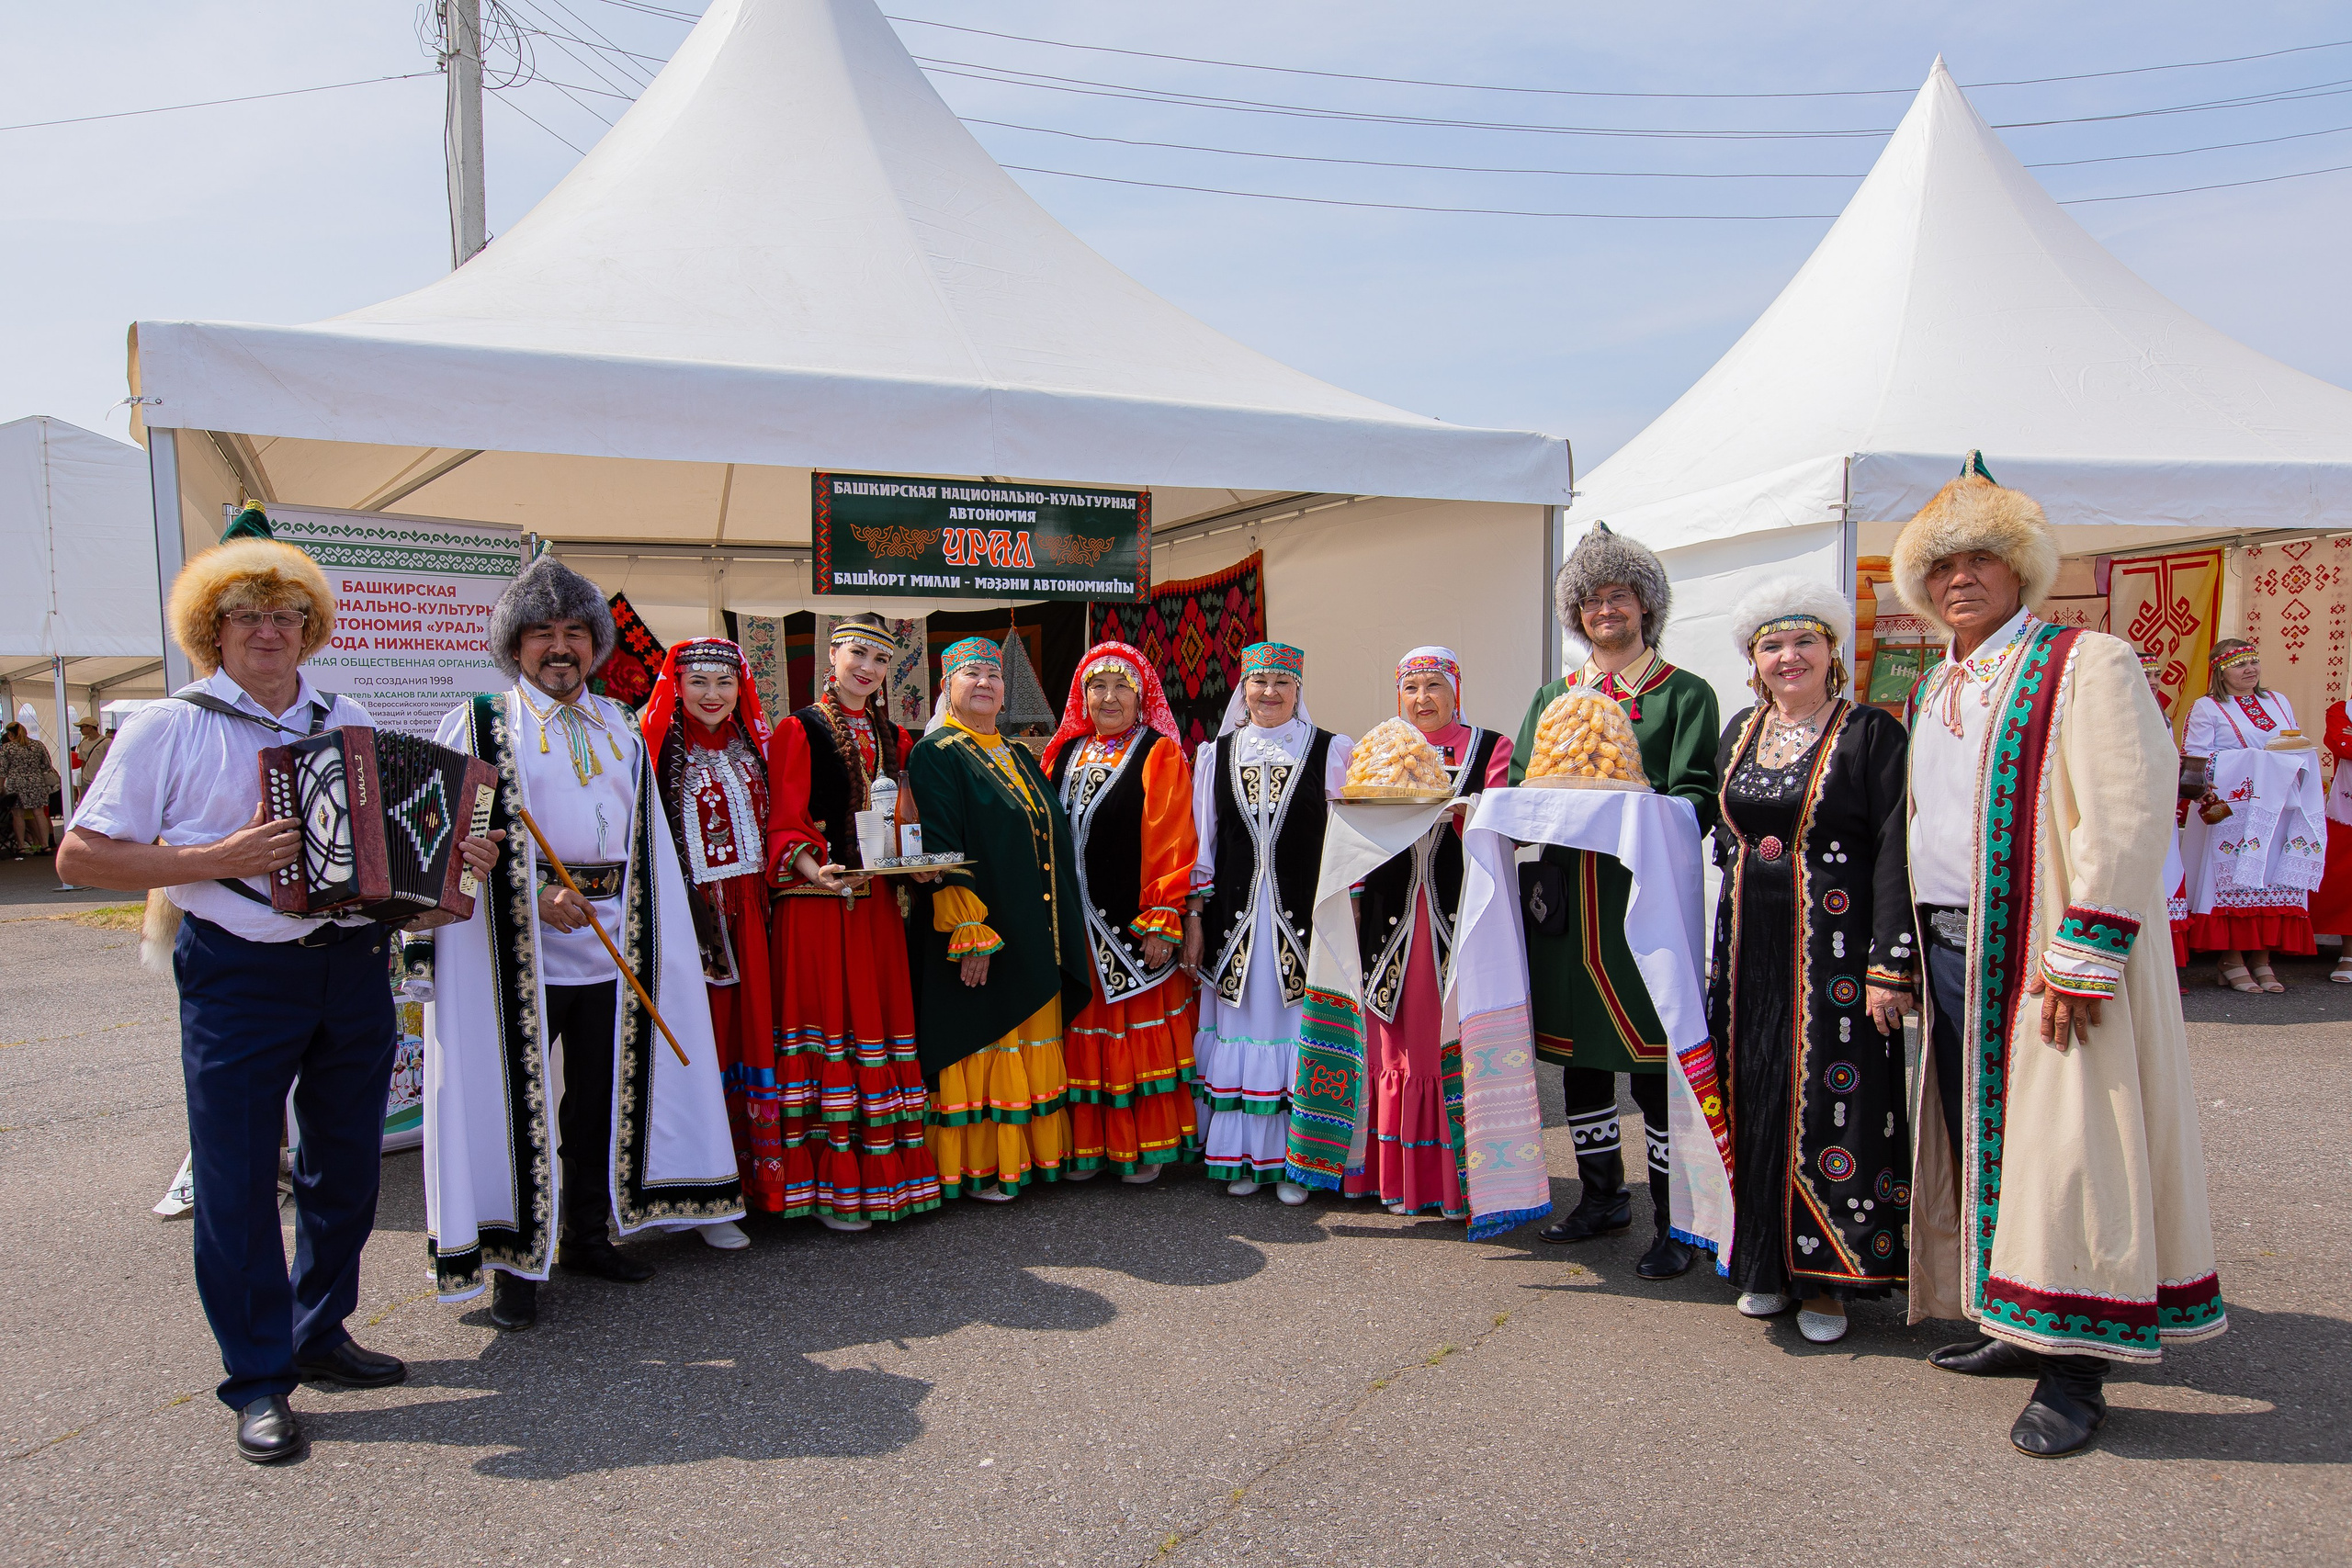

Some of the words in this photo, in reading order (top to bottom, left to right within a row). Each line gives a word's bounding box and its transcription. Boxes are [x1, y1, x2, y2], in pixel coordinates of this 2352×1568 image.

[833, 481, 936, 499] БАШКИРСКАЯ
[941, 487, 1136, 510] НАЦИОНАЛЬНО-КУЛЬТУРНАЯ
[949, 507, 1036, 524] АВТОНОМИЯ
[942, 527, 1035, 569] УРАЛ
[910, 575, 960, 588] МИЛЛИ
[342, 580, 457, 597] БАШКИРСКАЯ
[426, 621, 484, 634] «УРАЛ»
[330, 636, 368, 651] ОДА
[374, 637, 491, 651] НИЖНЕКАМСК
[301, 657, 337, 667] ТНАЯ
[340, 658, 435, 668] ОБЩЕСТВЕННАЯ
[354, 677, 374, 686] ГОД
[375, 677, 428, 686] СОЗДАНИЯ
[430, 676, 454, 685] 1998
[373, 691, 415, 699] ХАСАНОВ
[368, 701, 429, 709] Всероссийского
[409, 718, 433, 727] сфере
